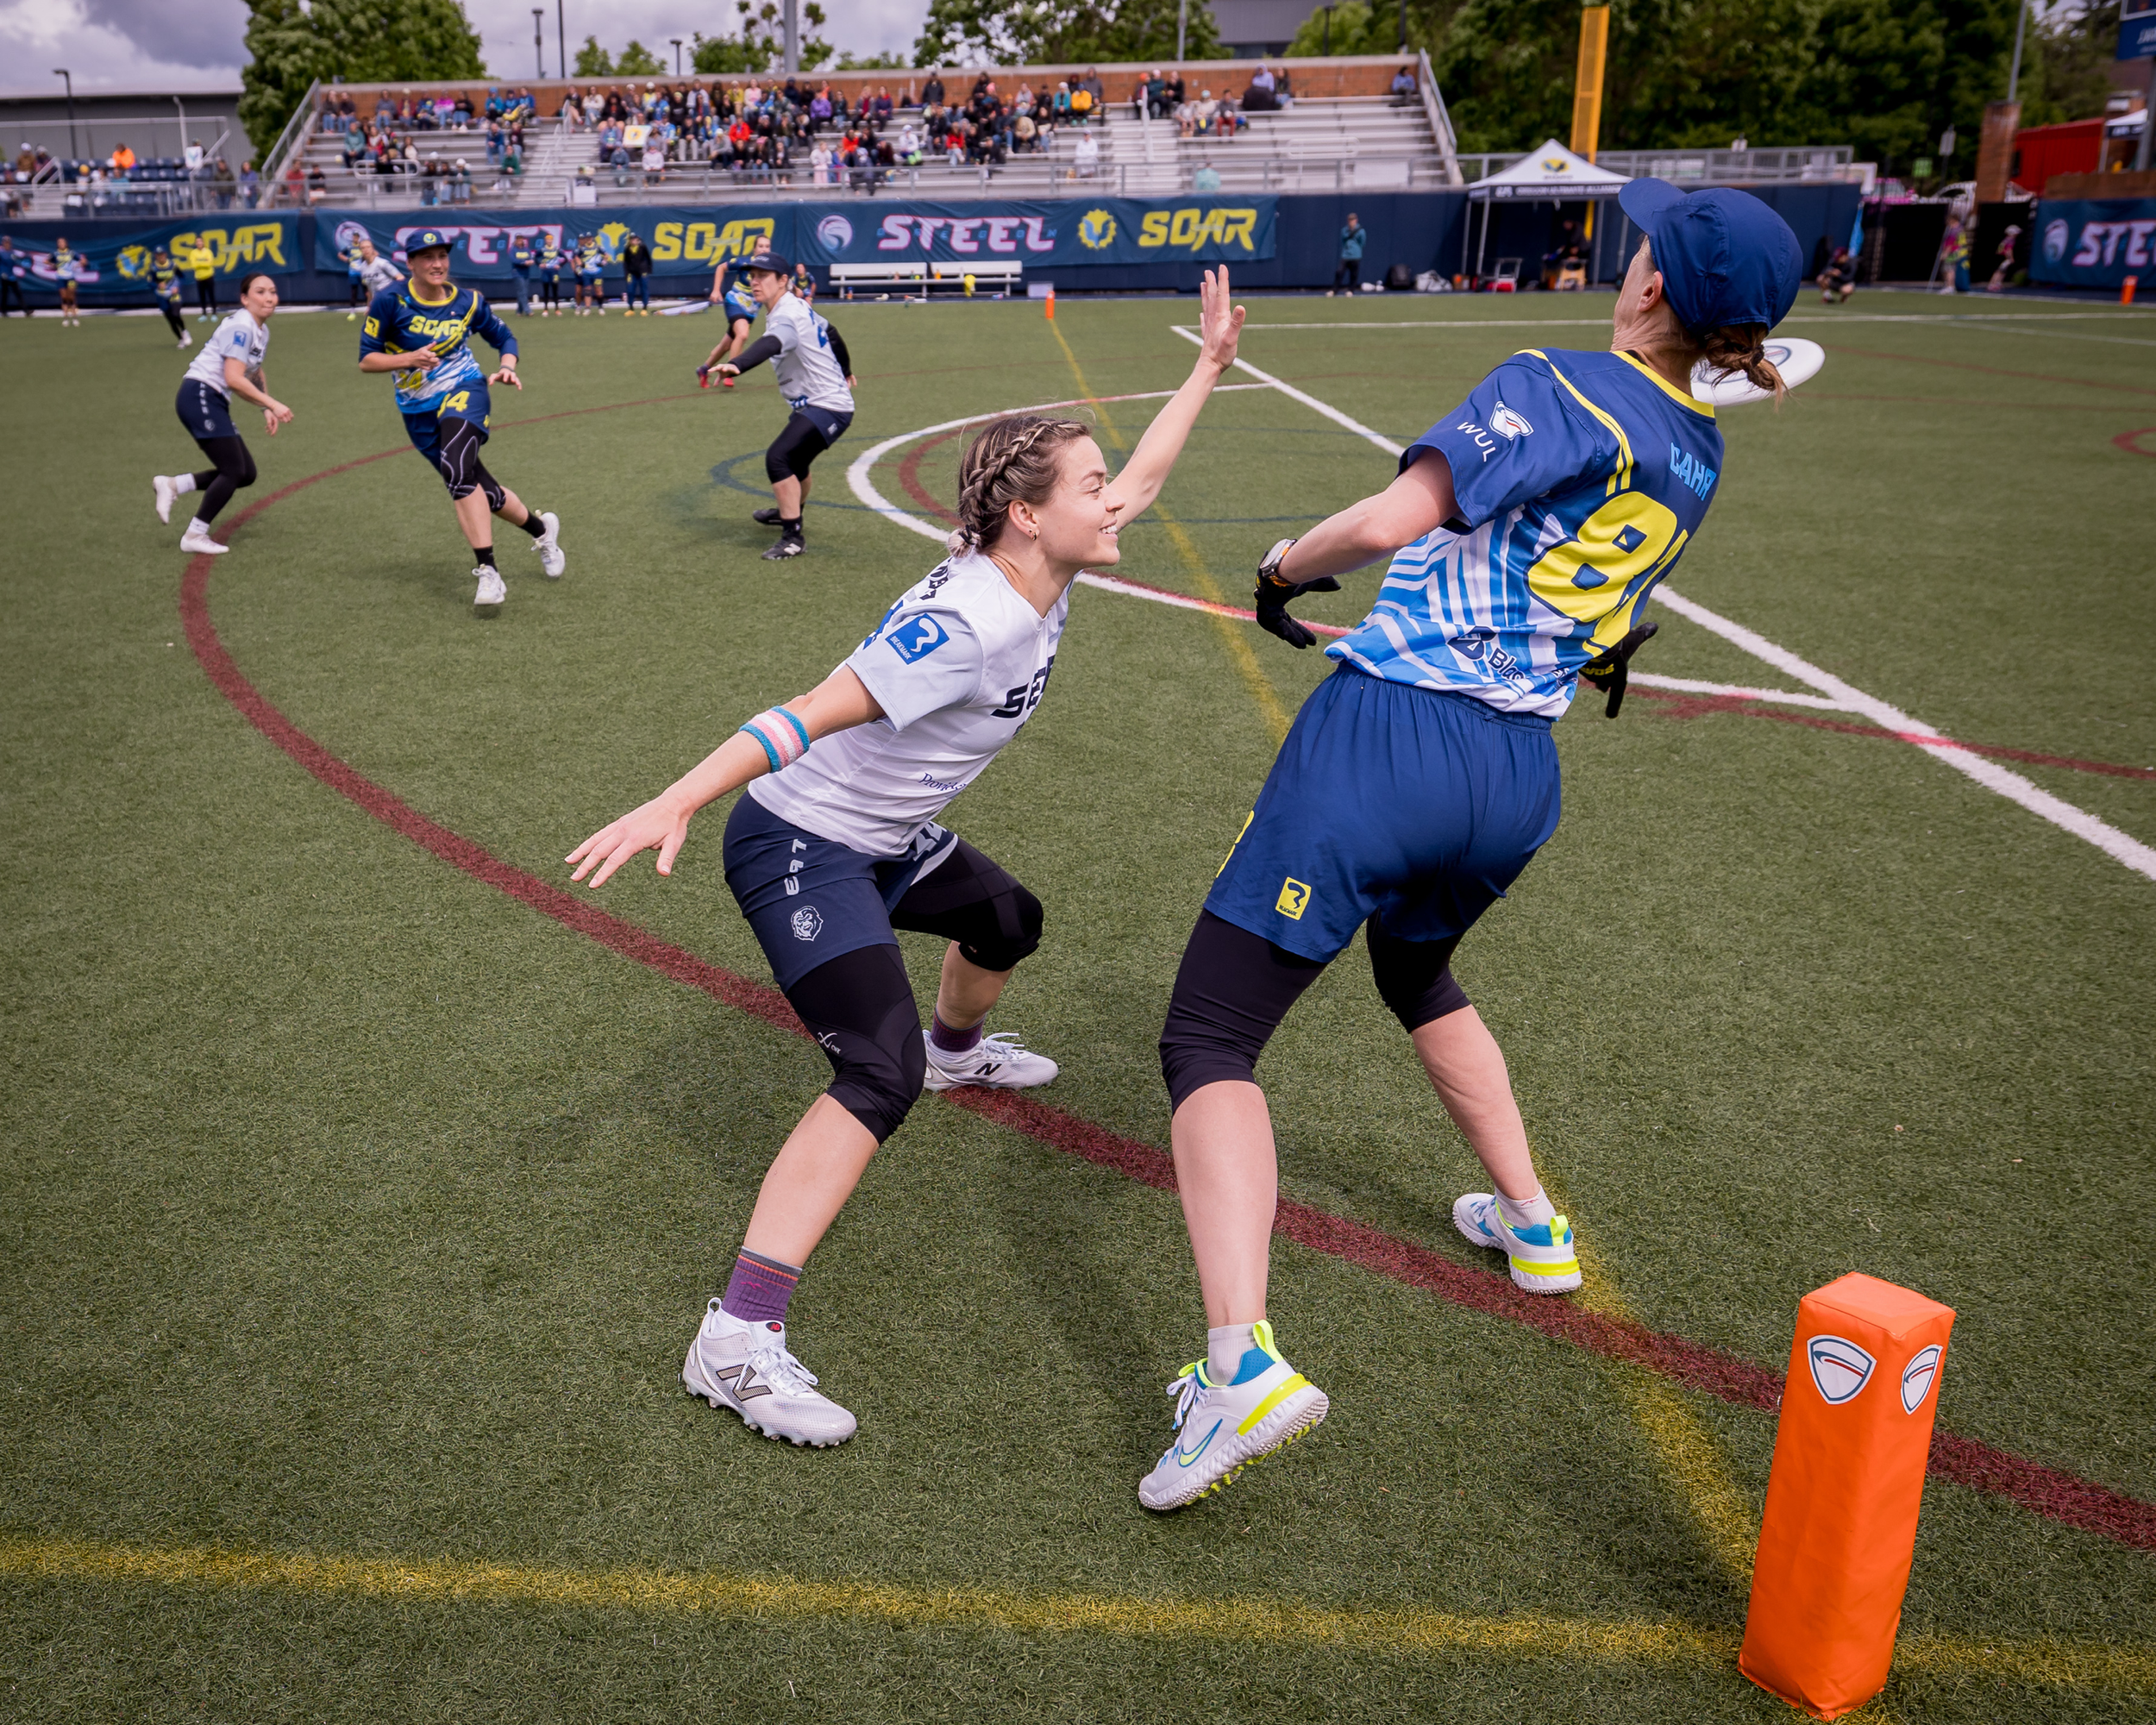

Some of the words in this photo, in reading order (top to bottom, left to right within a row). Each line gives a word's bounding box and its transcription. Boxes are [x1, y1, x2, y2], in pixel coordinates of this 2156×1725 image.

[169, 222, 286, 273] SOAR
[878, 214, 1055, 253] STEEL
[1138, 208, 1257, 252] SOAR
[2071, 217, 2156, 268] STE
[1457, 421, 1496, 462] WUL
[1670, 442, 1717, 501] CAHR
[889, 636, 912, 660] BREAKMARK
